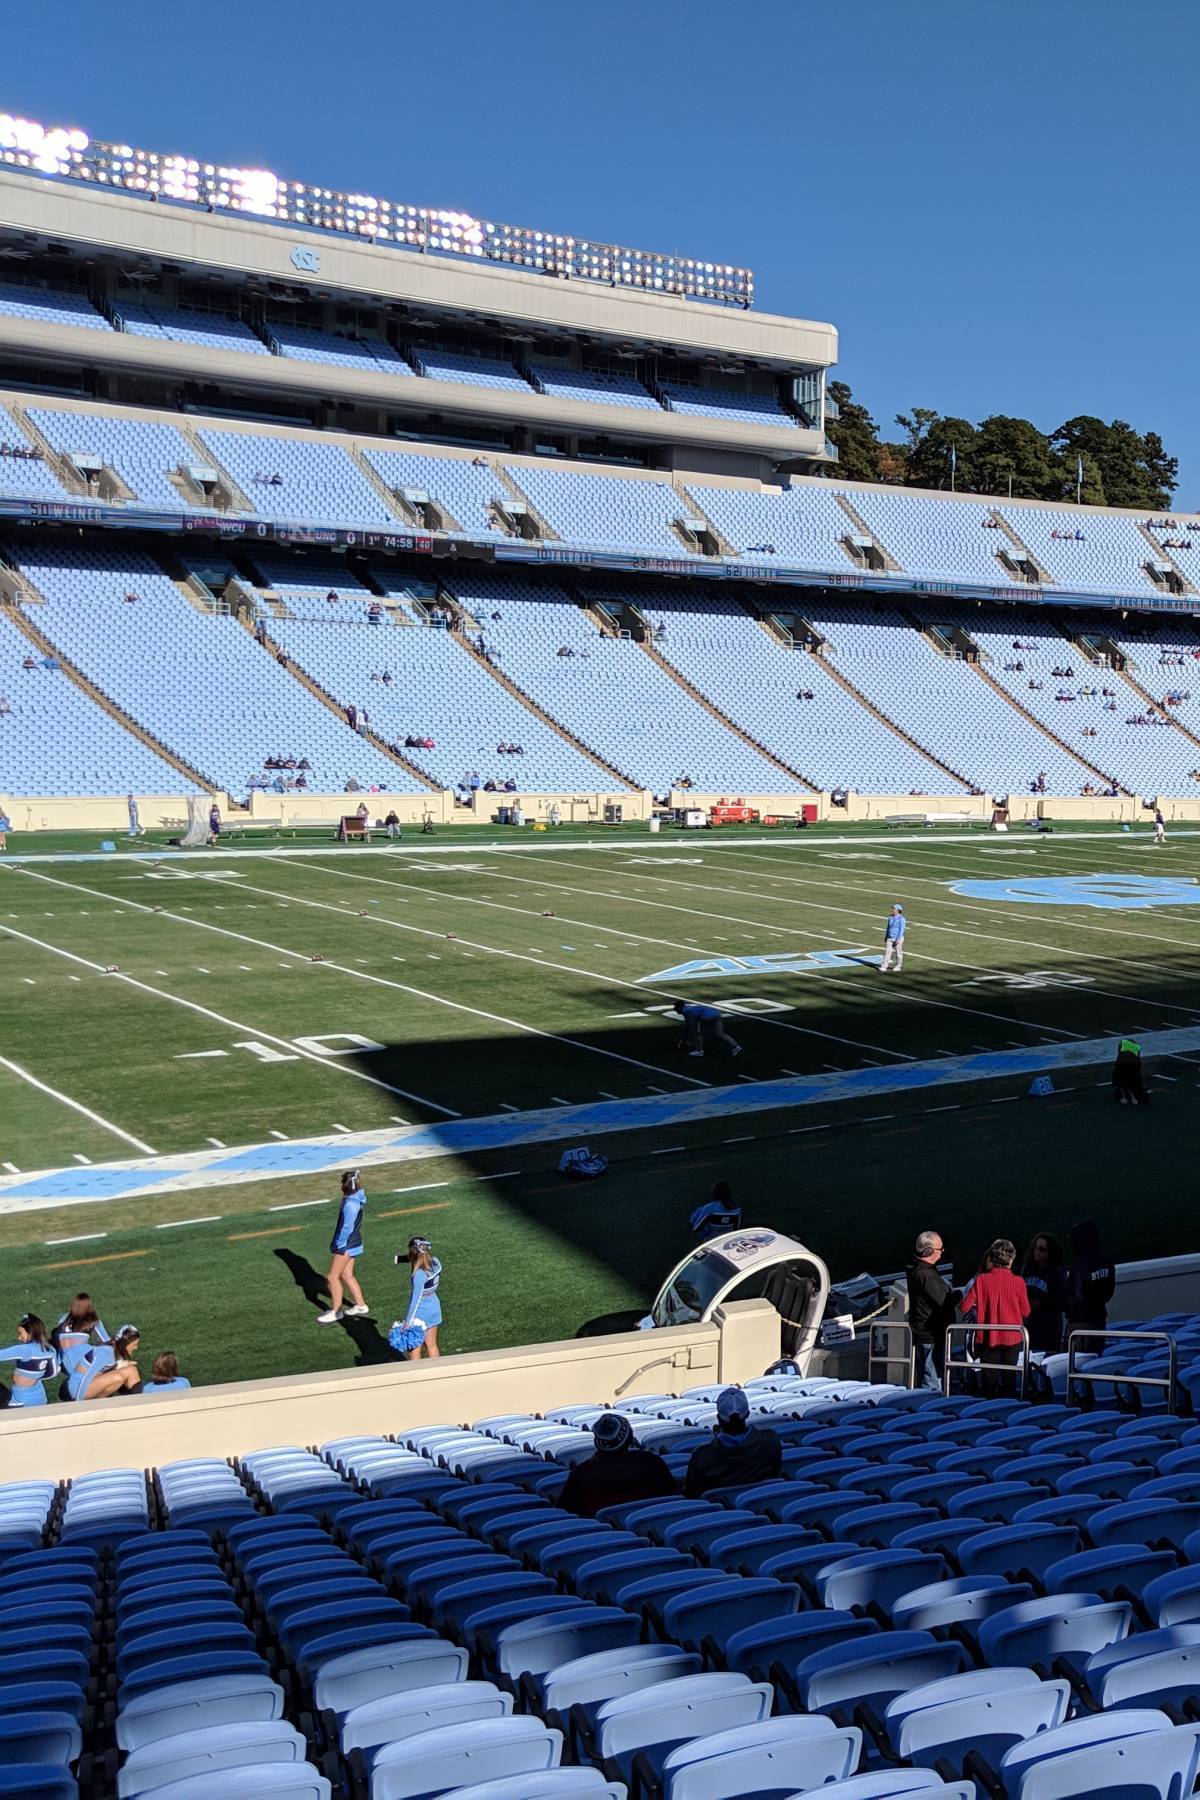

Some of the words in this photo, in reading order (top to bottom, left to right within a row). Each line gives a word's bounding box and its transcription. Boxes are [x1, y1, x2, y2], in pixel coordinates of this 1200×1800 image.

[53, 505, 102, 521] WEINER
[222, 521, 246, 533] WCU
[257, 523, 267, 537] 0
[315, 530, 337, 541] UNC
[346, 532, 356, 545] 0
[384, 536, 413, 549] 74:58
[551, 551, 593, 565] TALBOTT
[1114, 597, 1154, 609] WELCOME
[1158, 600, 1168, 609] TO
[634, 948, 888, 983] ACC
[972, 971, 1097, 990] 30
[231, 1033, 389, 1063] 10
